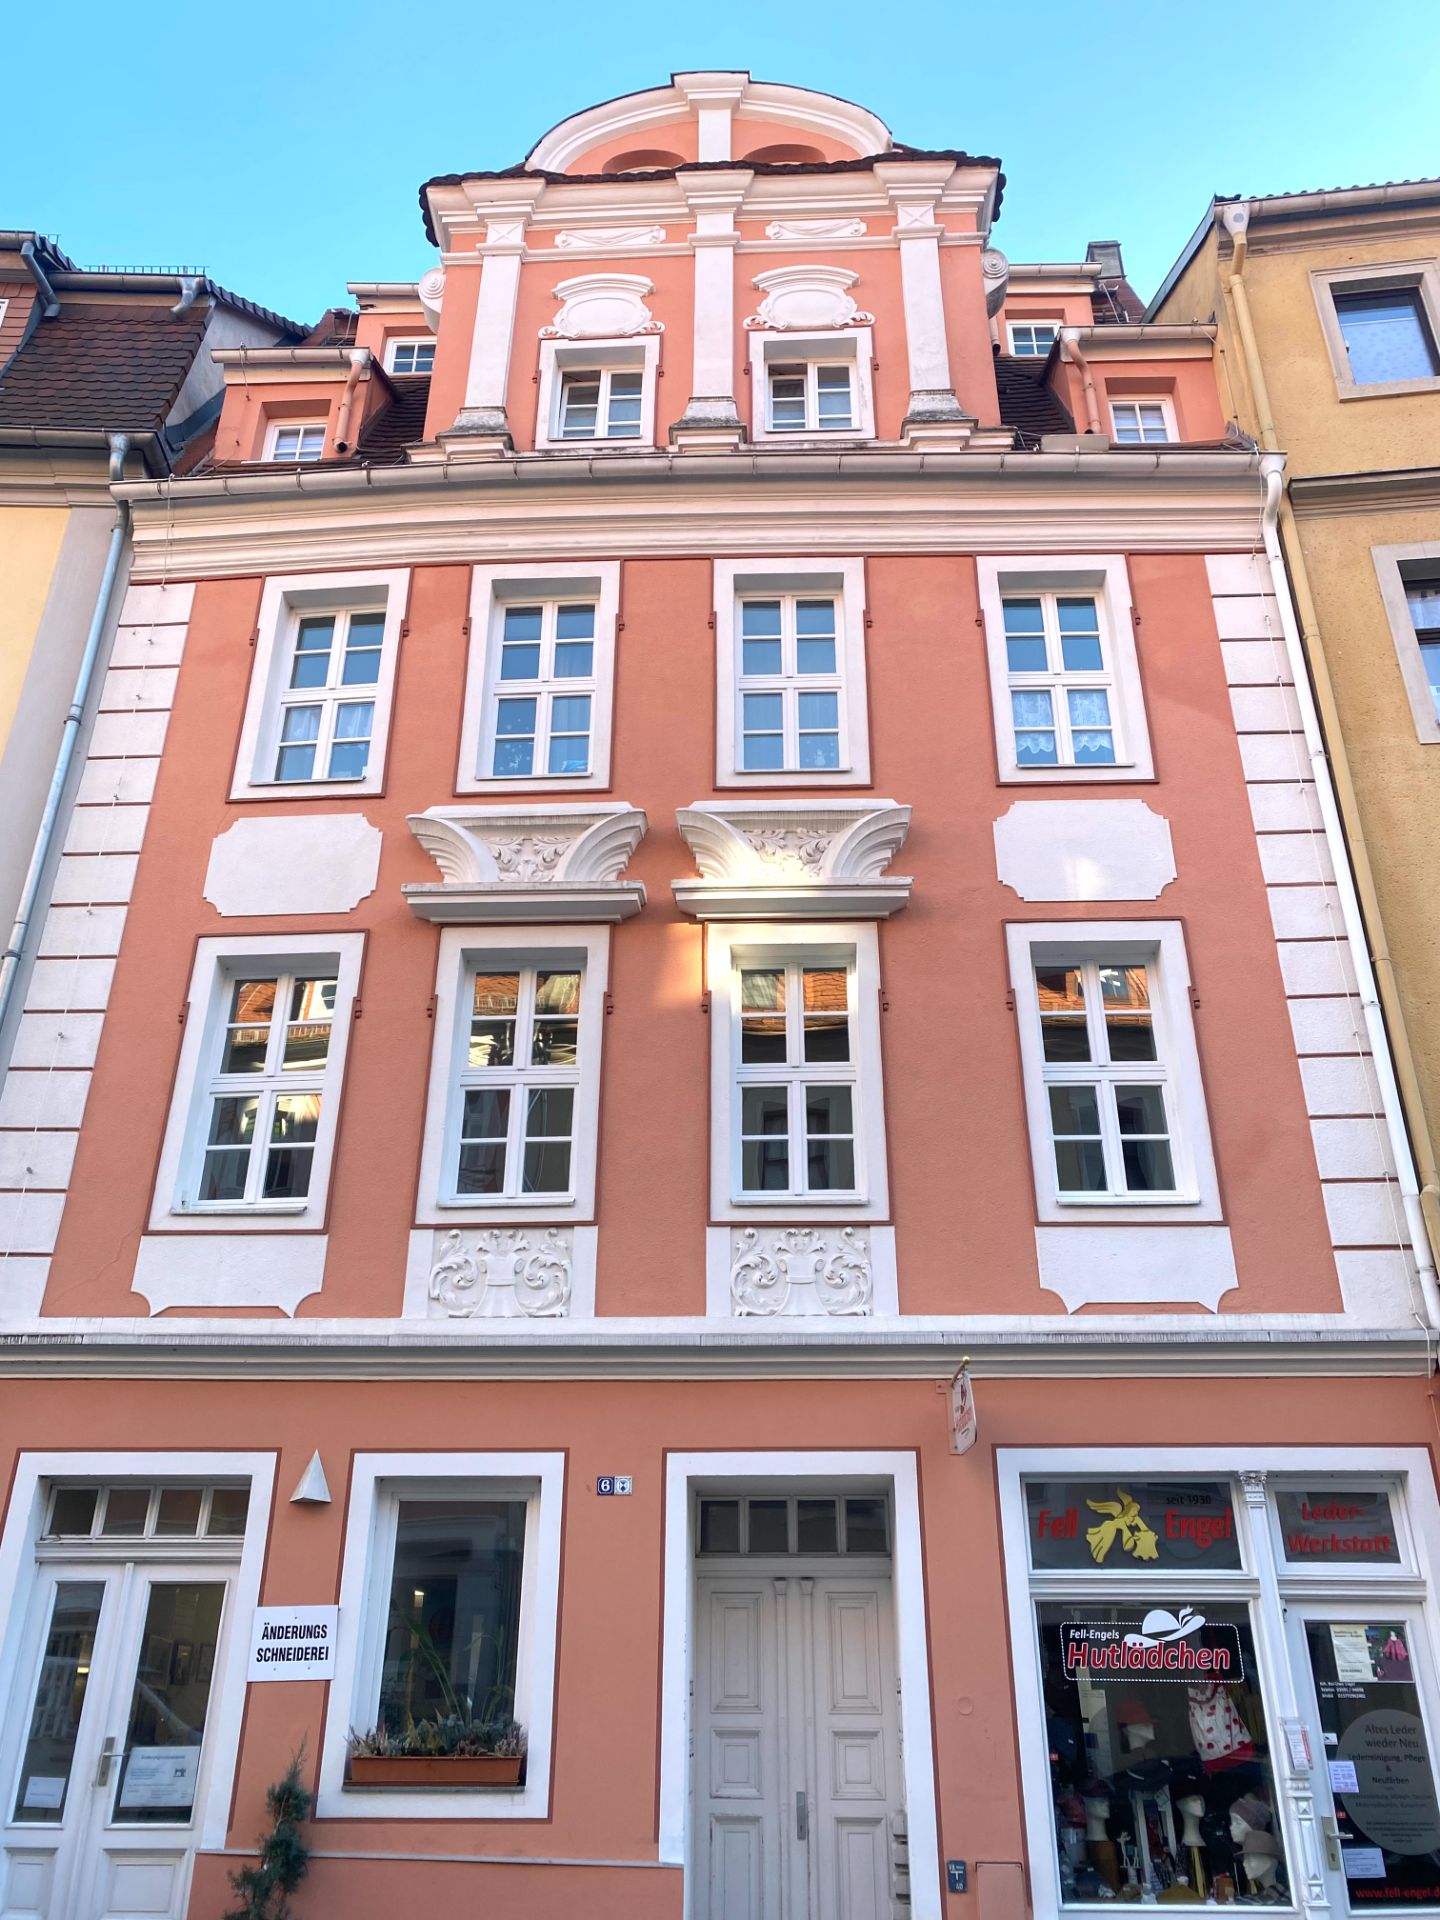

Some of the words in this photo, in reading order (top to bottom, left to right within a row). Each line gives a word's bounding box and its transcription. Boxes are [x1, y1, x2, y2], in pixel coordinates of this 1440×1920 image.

[601, 1479, 611, 1492] 6
[1165, 1495, 1185, 1505] seit
[1187, 1495, 1212, 1505] 1930
[1301, 1502, 1366, 1521] Leder-
[1037, 1508, 1079, 1540] Fell
[1165, 1509, 1232, 1548] Engel
[1288, 1532, 1392, 1553] Werkstatt
[261, 1622, 328, 1640] ÄNDERUNGS
[1069, 1629, 1120, 1641] Fell-Engels
[256, 1646, 329, 1662] SCHNEIDEREI
[1067, 1641, 1231, 1670] Hutlädchen
[1364, 1724, 1388, 1734] Altes
[1390, 1724, 1417, 1735] Leder
[1364, 1737, 1397, 1748] wieder
[1403, 1754, 1426, 1763] Pflege
